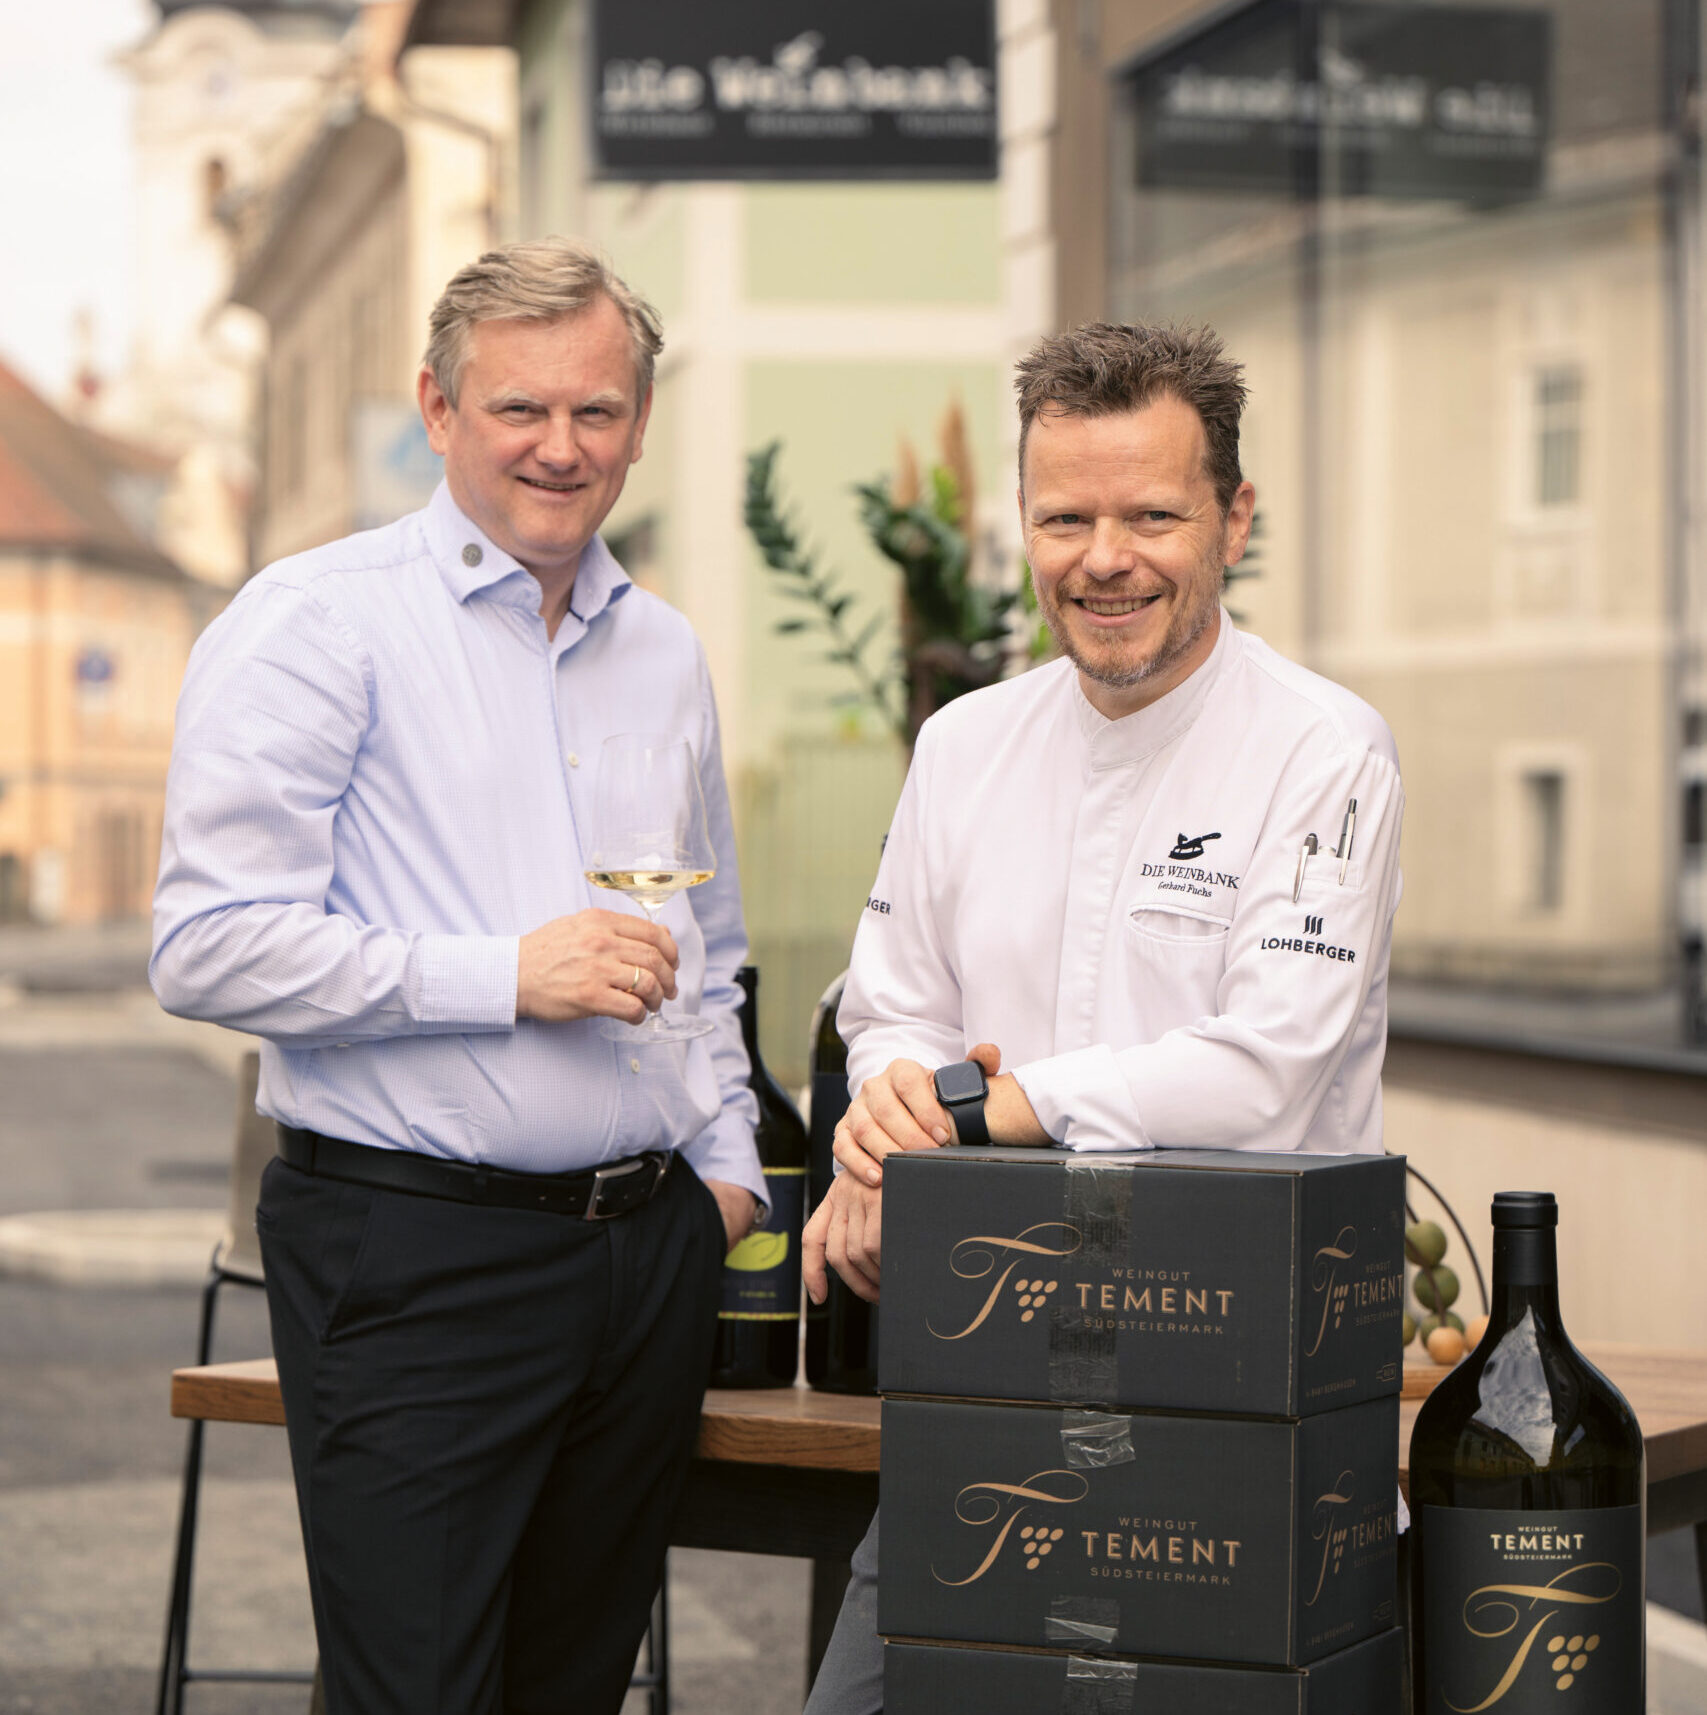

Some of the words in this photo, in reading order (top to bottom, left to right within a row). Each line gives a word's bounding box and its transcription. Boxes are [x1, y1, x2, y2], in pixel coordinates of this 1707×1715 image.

[1141, 864, 1166, 877] DIE
[1168, 866, 1240, 889] WEINBANK
[1158, 881, 1187, 892] Gerhard
[1186, 884, 1212, 897] Fuchs
[1261, 938, 1356, 963] LOHBERGER
[1112, 1268, 1191, 1281] WEINGUT
[1076, 1283, 1234, 1316] TEMENT
[1353, 1274, 1403, 1308] TEMENT
[1084, 1318, 1224, 1334] SÜDSTEIERMARK
[1118, 1517, 1198, 1531] WEINGUT
[1081, 1531, 1241, 1567] TEMENT
[1490, 1534, 1585, 1550] TEMENT
[1090, 1567, 1232, 1586] SÜDSTEIERMARK
